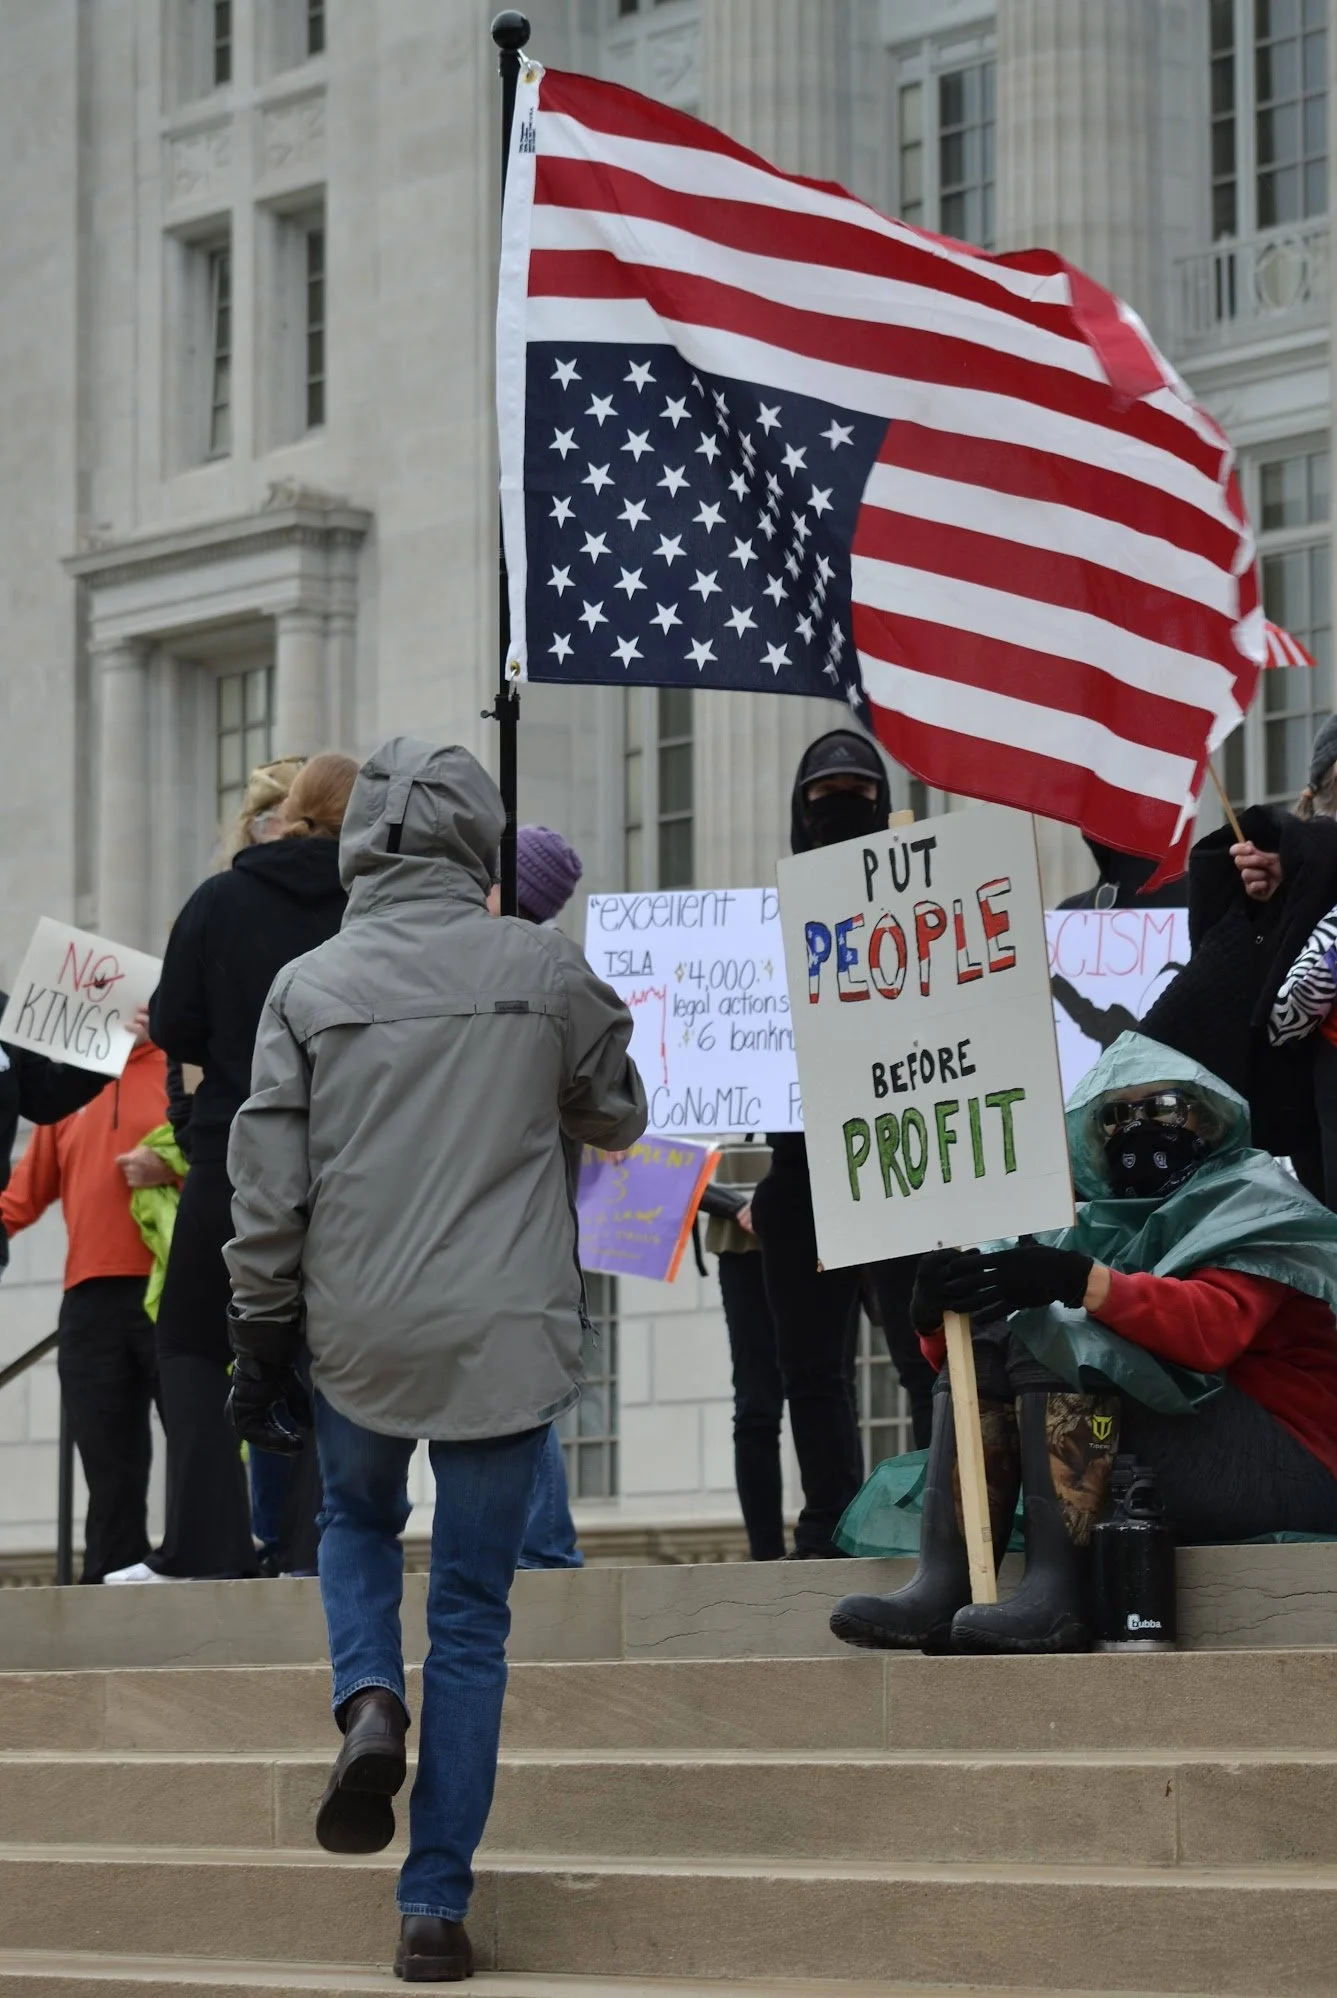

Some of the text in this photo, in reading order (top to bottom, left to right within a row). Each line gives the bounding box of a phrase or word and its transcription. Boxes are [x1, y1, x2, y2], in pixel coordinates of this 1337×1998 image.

[862, 836, 937, 902] PUT
[604, 949, 655, 976] TSLA
[804, 876, 1017, 1004] PEOPLE
[57, 941, 125, 1003] NO
[689, 959, 757, 992] 4,000
[15, 982, 121, 1061] KINGS
[673, 991, 790, 1028] legal actions
[697, 1020, 717, 1051] 6
[872, 1038, 977, 1099] BEFORE
[842, 1087, 1026, 1202] PROFIT
